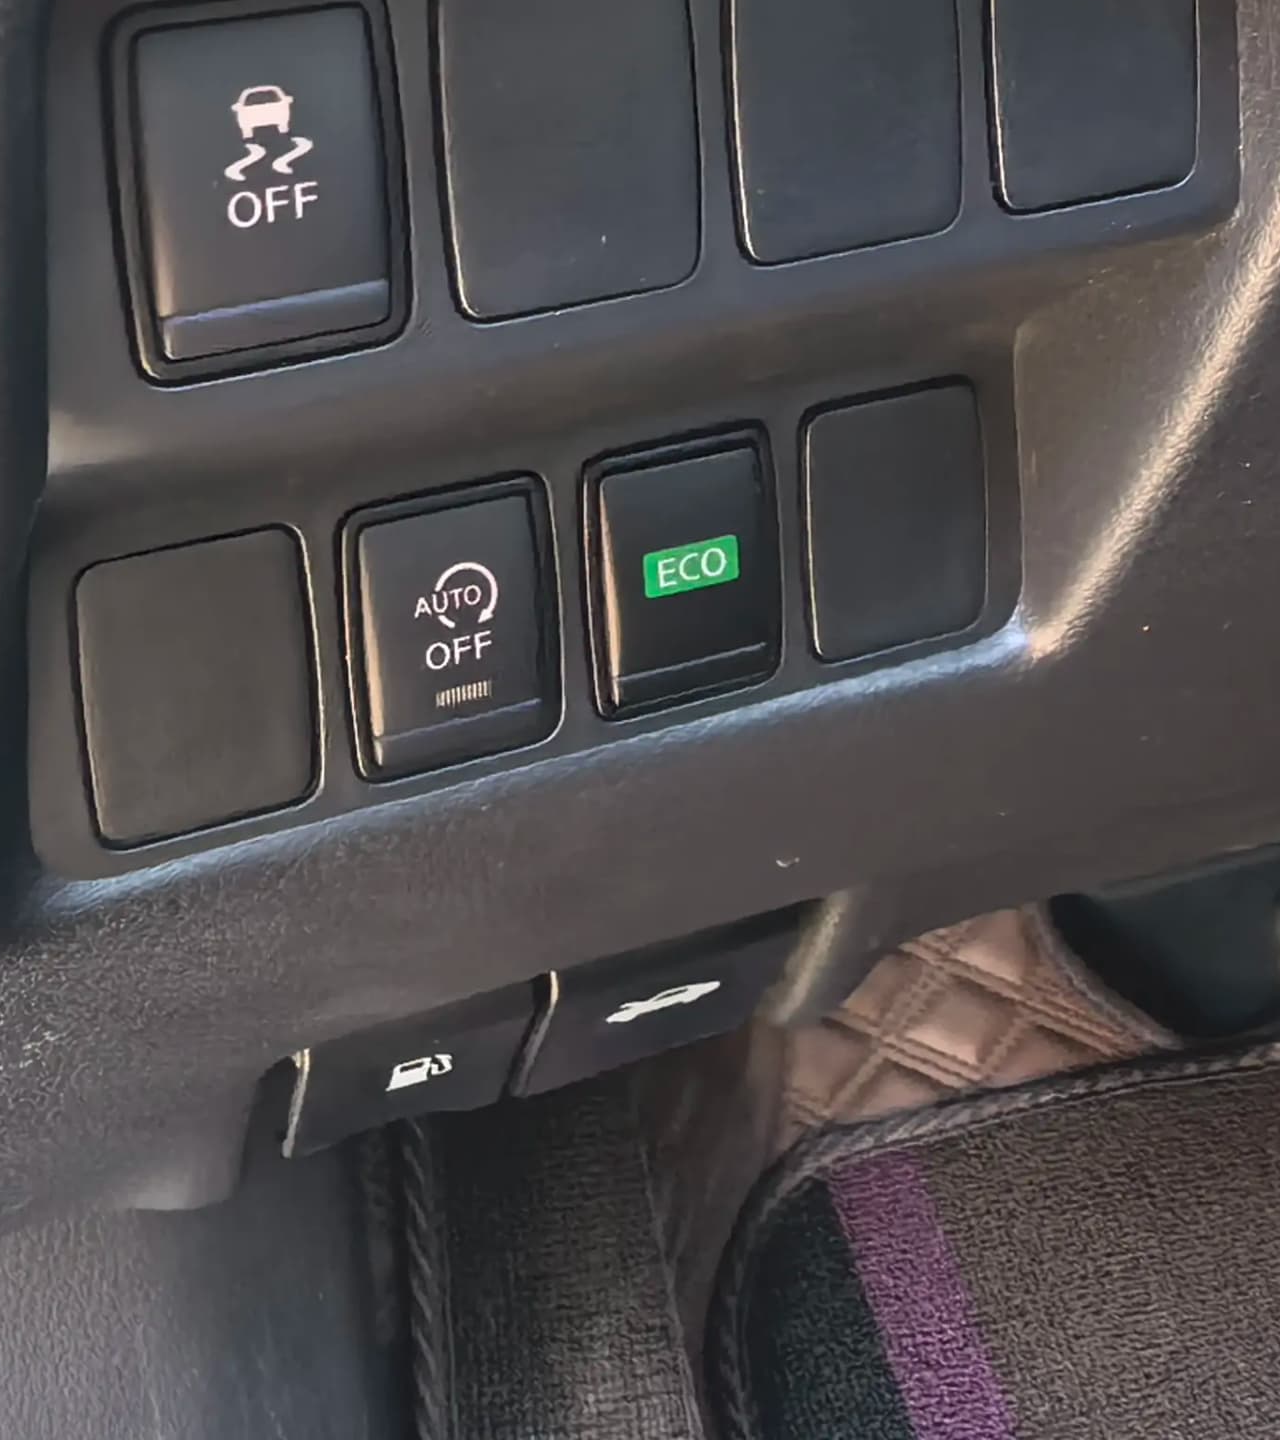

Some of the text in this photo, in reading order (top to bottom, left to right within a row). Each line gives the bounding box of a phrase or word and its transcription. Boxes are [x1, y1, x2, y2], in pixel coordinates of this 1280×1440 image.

[227, 180, 319, 229] OFF
[656, 547, 728, 589] ECO
[413, 583, 483, 619] AUTO
[425, 629, 493, 671] OFF
